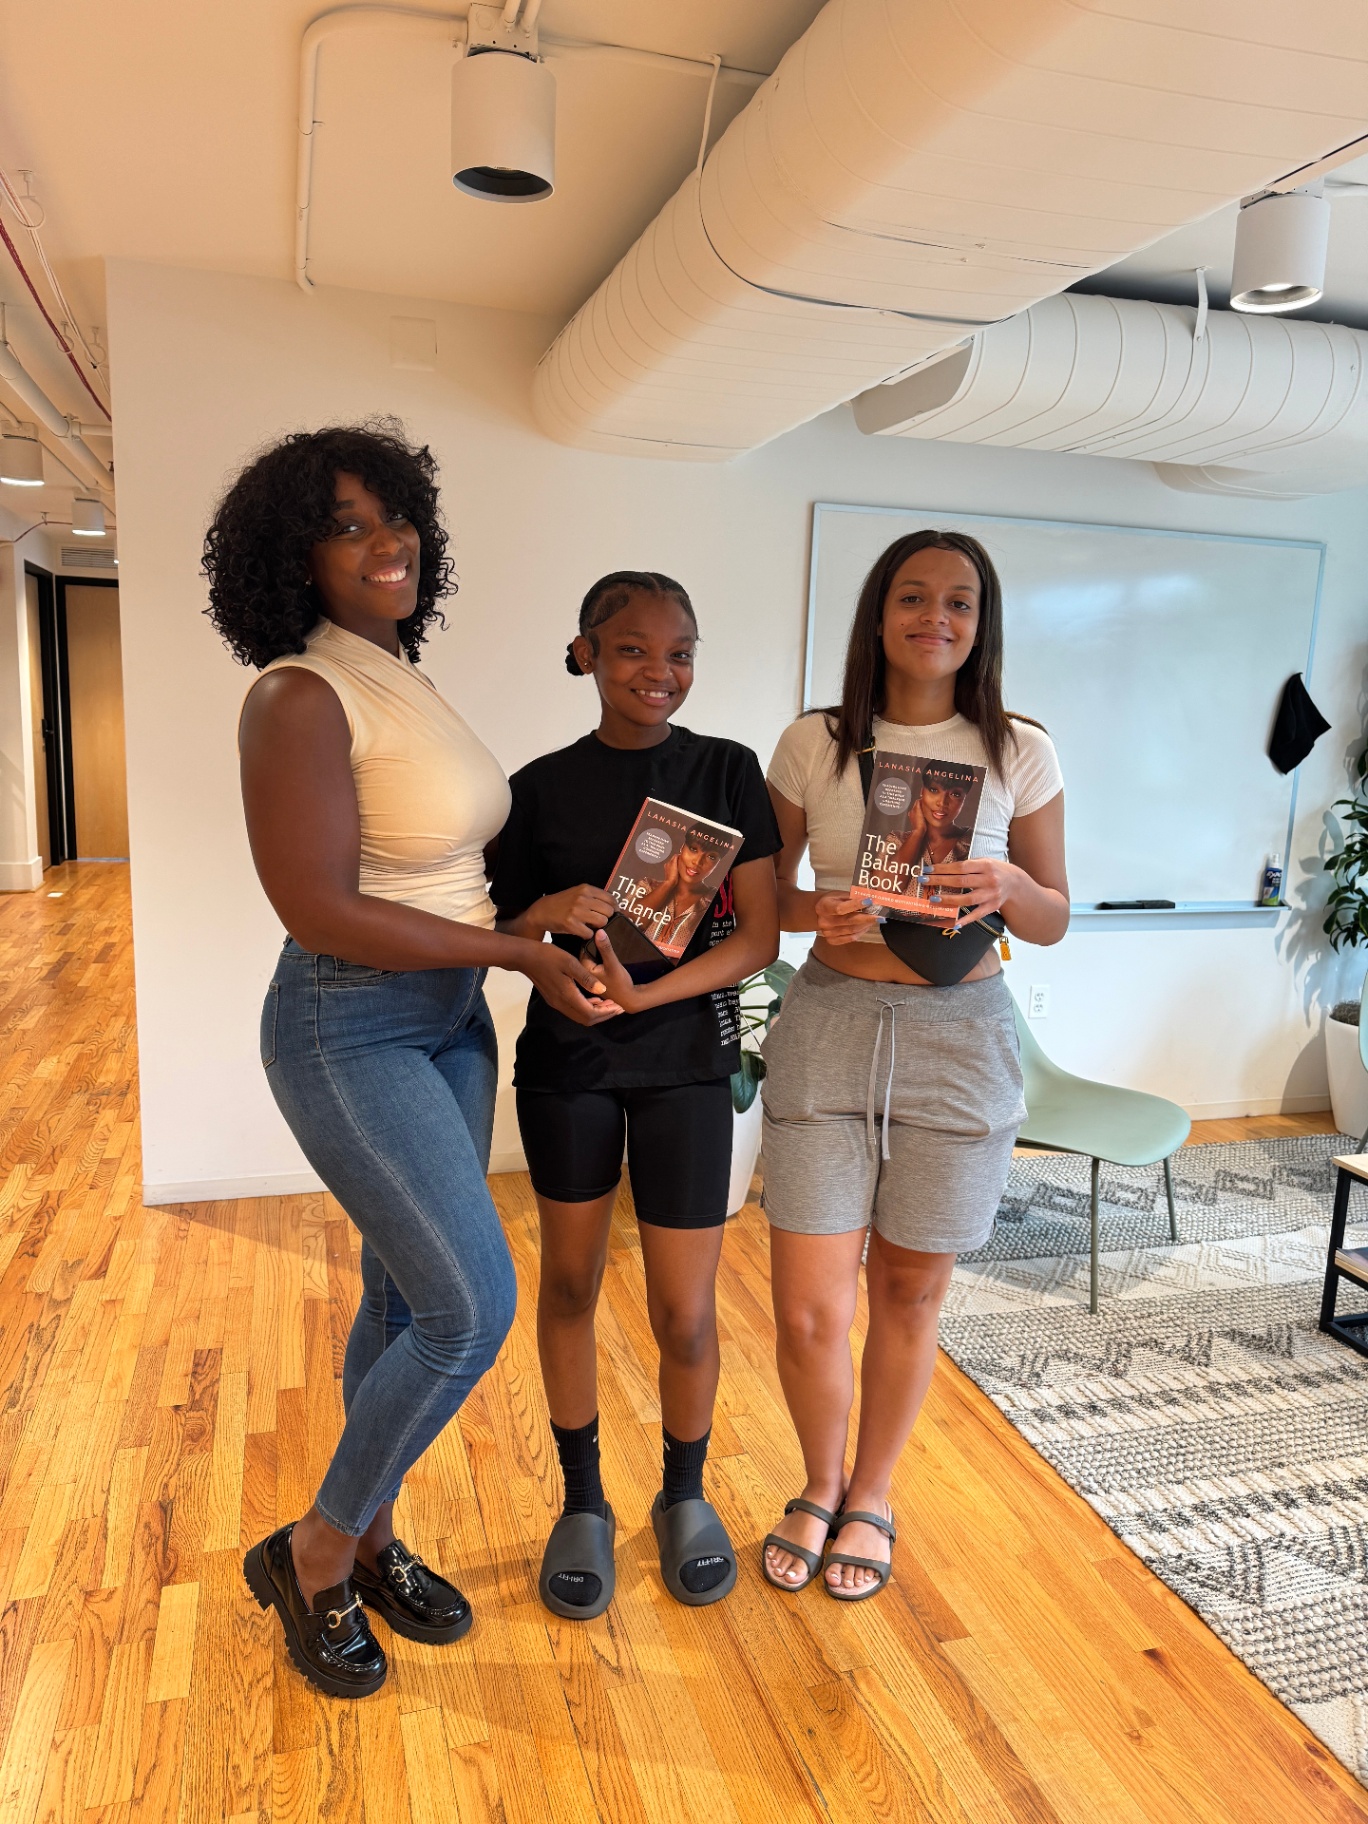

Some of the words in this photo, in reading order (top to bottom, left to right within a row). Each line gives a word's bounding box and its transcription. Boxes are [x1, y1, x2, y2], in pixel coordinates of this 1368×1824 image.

[878, 761, 922, 774] LANASIA
[926, 769, 979, 783] ANGELINA
[647, 811, 687, 832] LANASIA
[690, 829, 735, 850] ANGELINA
[865, 833, 897, 855] The
[861, 852, 922, 878] Balanc
[615, 875, 647, 899] The
[858, 869, 903, 893] Book
